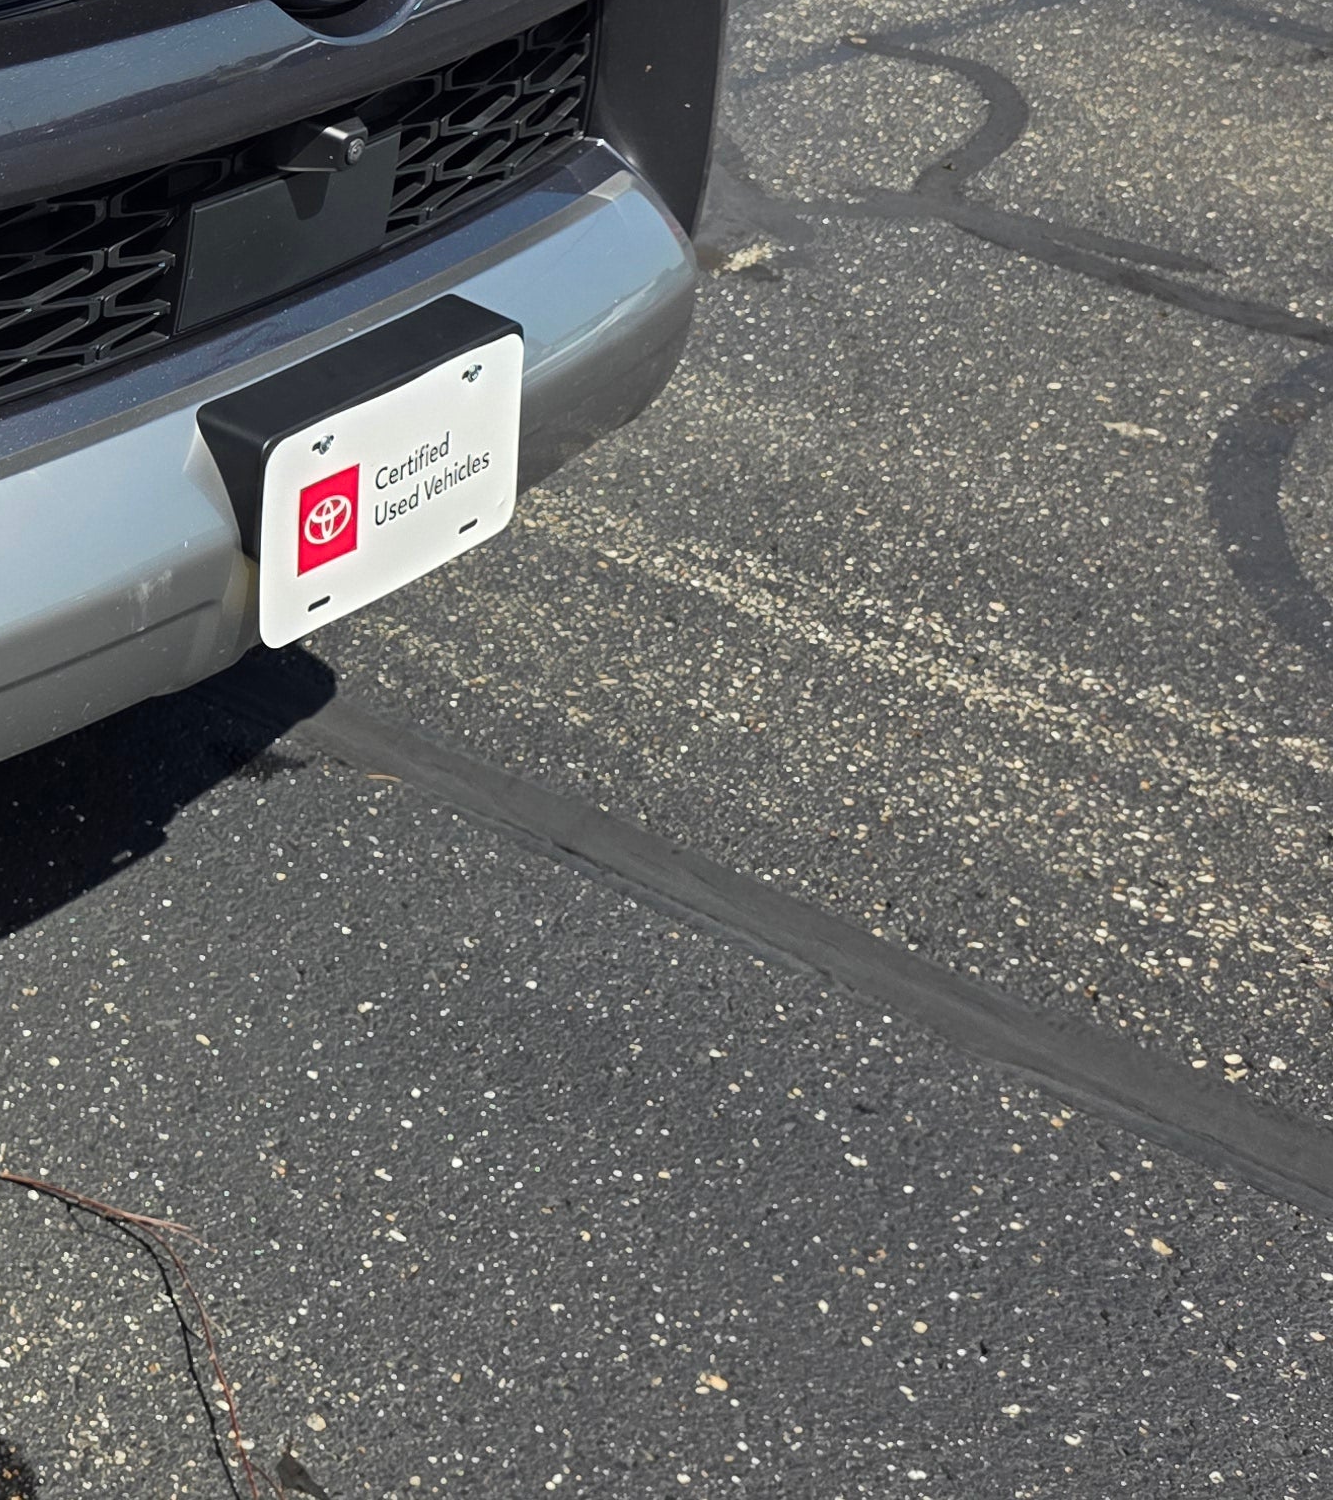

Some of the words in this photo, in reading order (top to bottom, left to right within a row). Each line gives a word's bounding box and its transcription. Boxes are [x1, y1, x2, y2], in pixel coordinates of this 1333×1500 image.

[374, 430, 450, 490] Certified
[374, 483, 420, 526] Used
[424, 451, 490, 501] Vehicles
